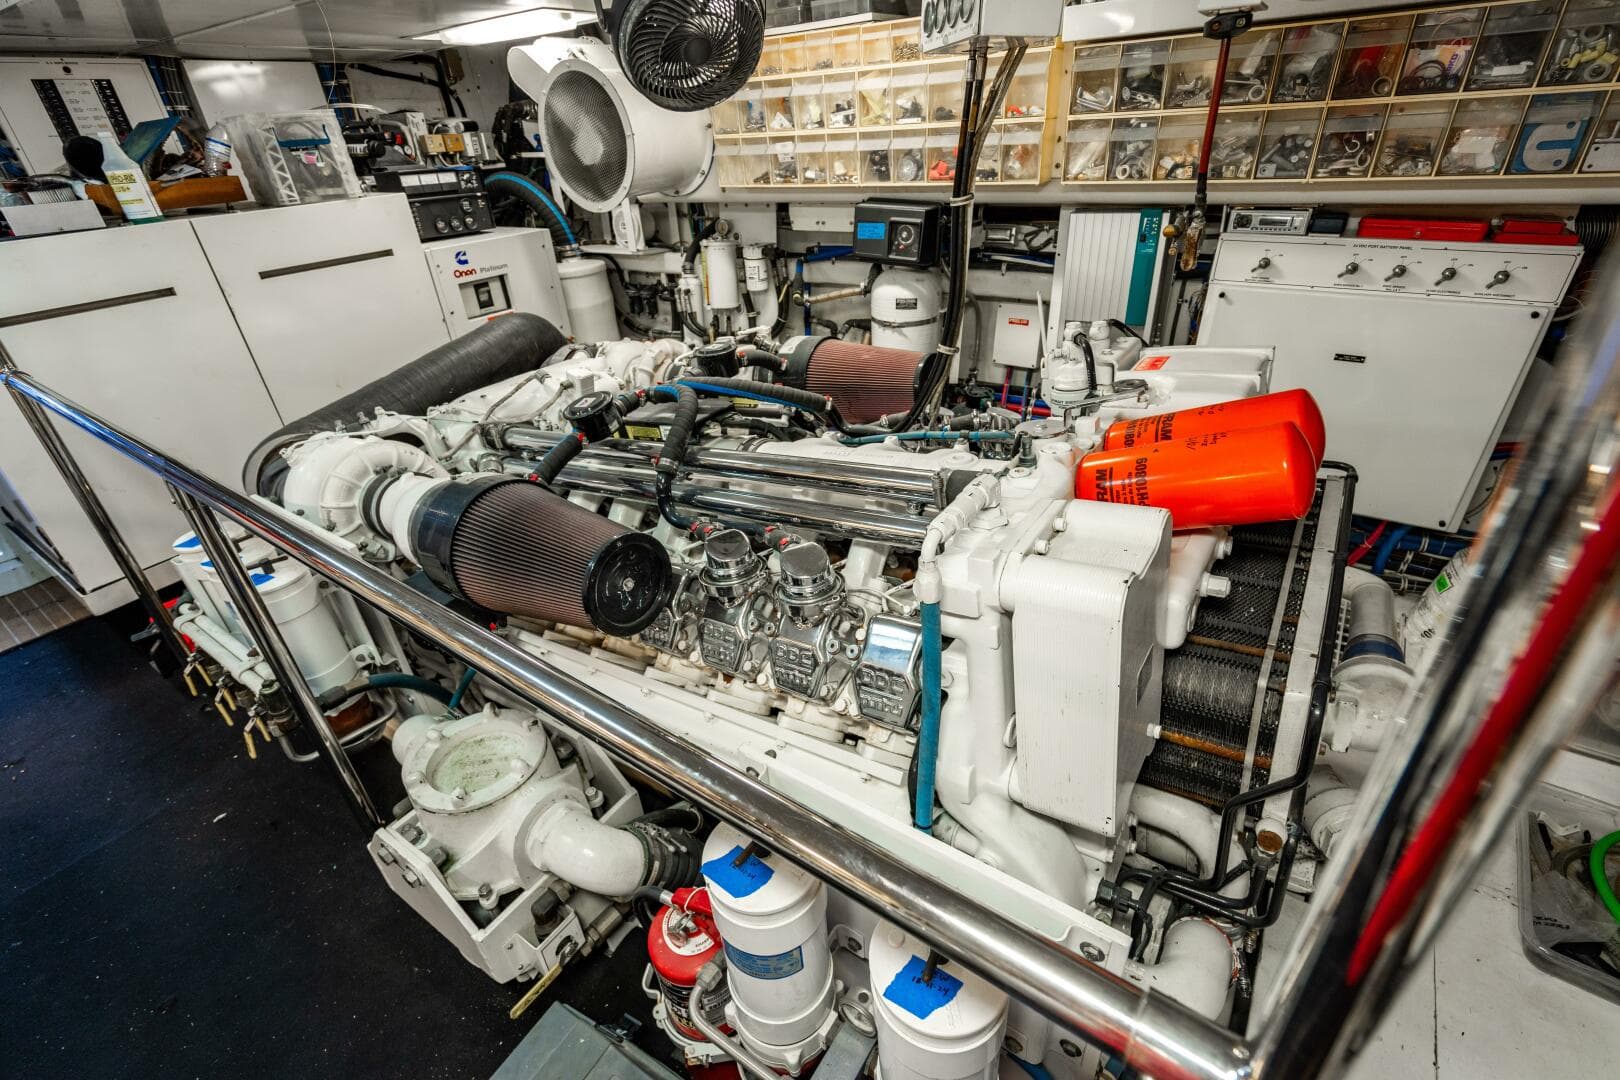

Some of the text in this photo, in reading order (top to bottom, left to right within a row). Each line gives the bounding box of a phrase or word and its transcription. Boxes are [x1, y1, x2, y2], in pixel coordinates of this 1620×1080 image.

[454, 269, 477, 278] Onan
[1161, 414, 1175, 440] RAM
[1096, 469, 1107, 501] RAM
[860, 668, 905, 693] DDC
